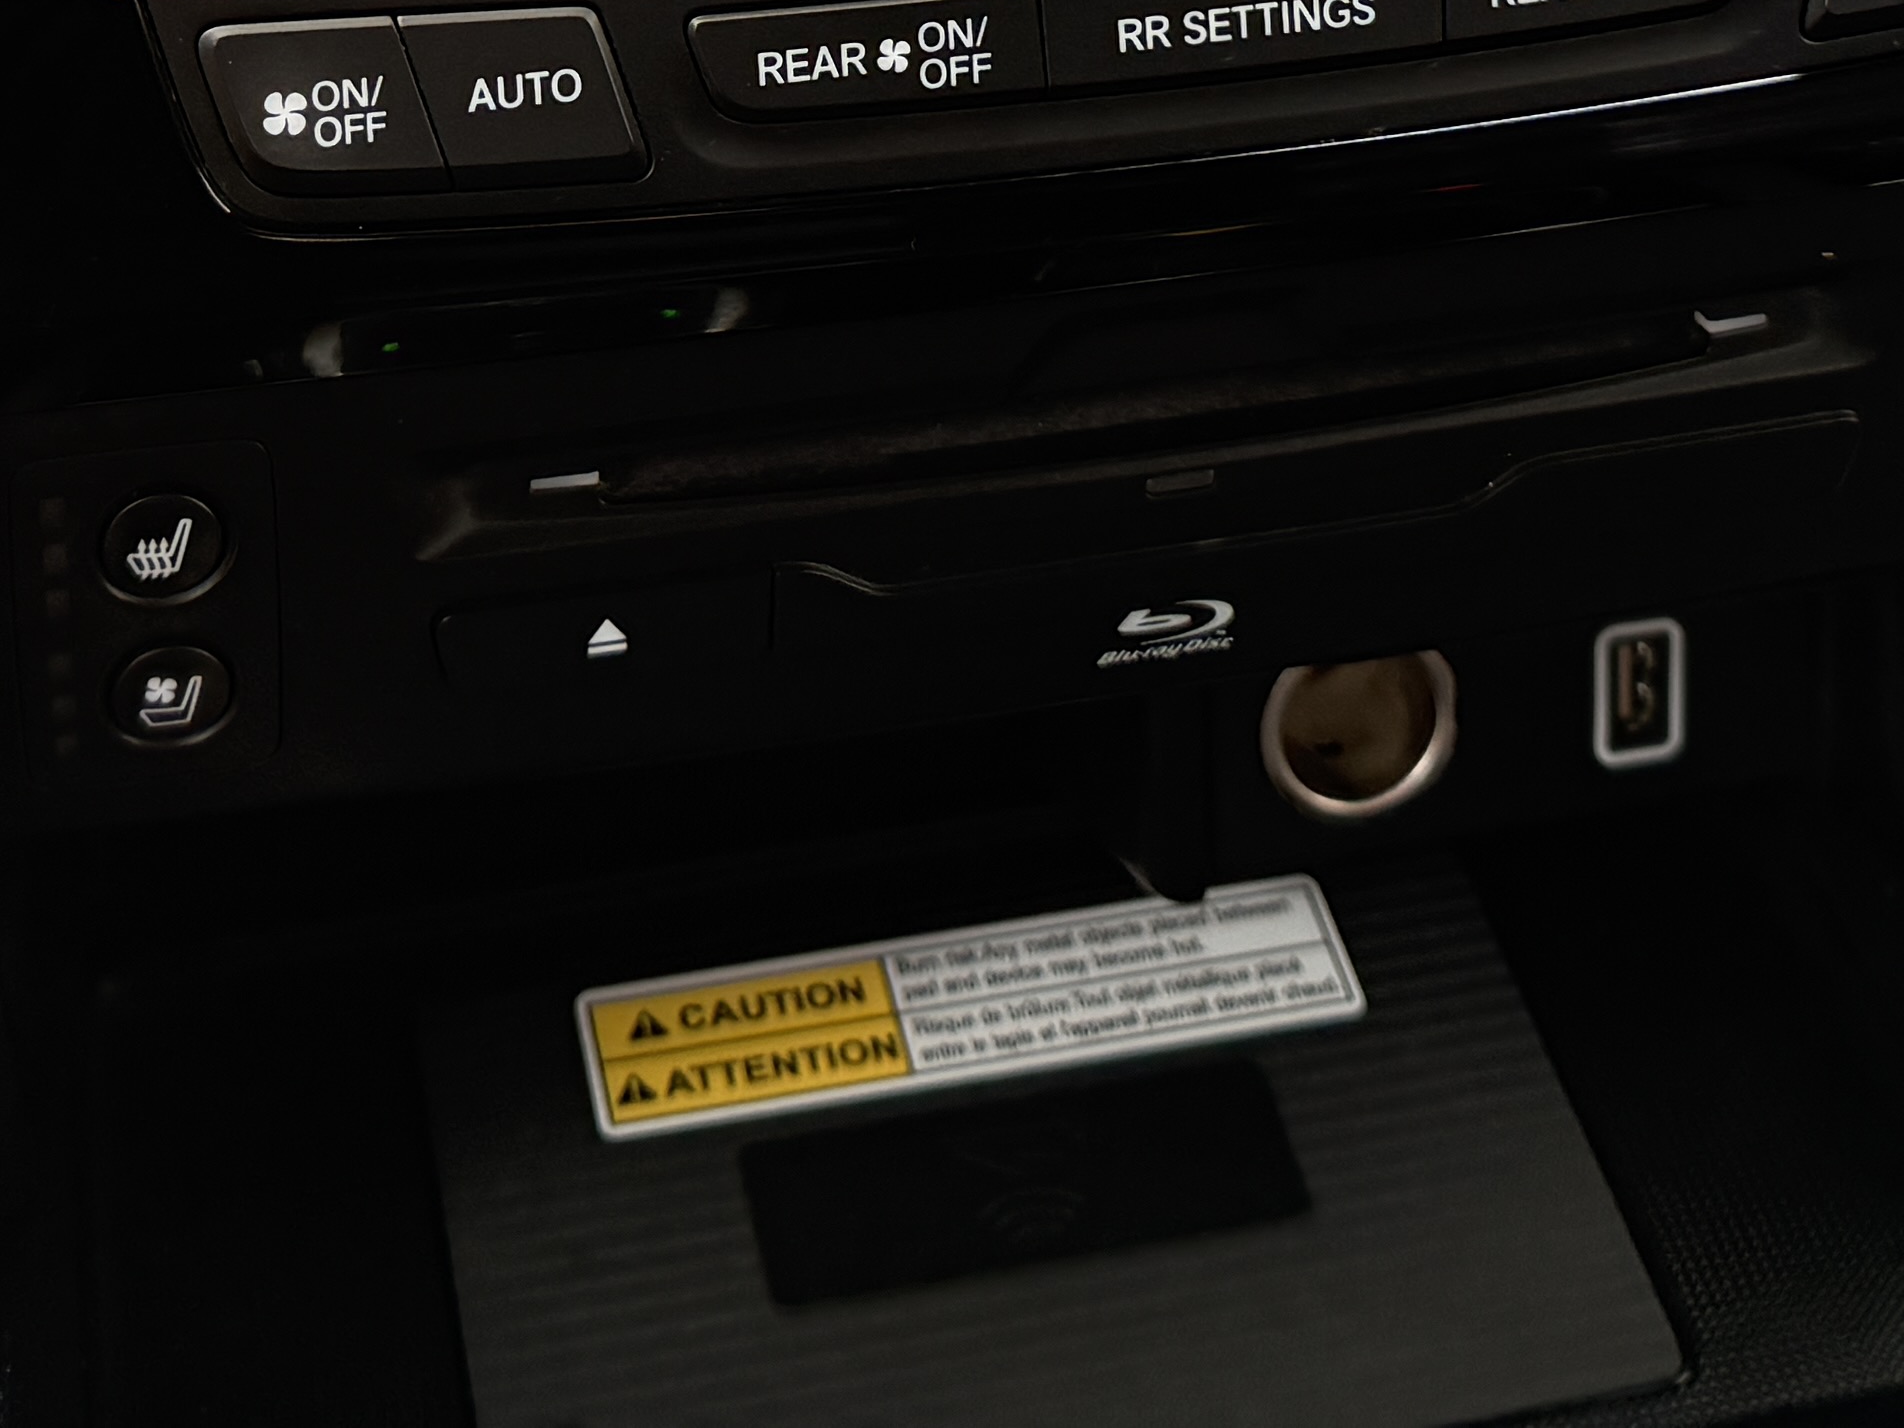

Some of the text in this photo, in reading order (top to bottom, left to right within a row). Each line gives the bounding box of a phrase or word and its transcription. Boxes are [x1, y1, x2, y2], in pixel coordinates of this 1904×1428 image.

[916, 14, 989, 55] ON/
[1116, 14, 1173, 54] RR
[756, 41, 869, 88] REAR
[918, 51, 993, 91] OFF
[310, 74, 383, 112] ON/
[467, 67, 583, 114] AUTO
[312, 109, 388, 149] OFF
[677, 976, 865, 1031] CAUTION
[666, 1031, 897, 1098] ATTENTION
